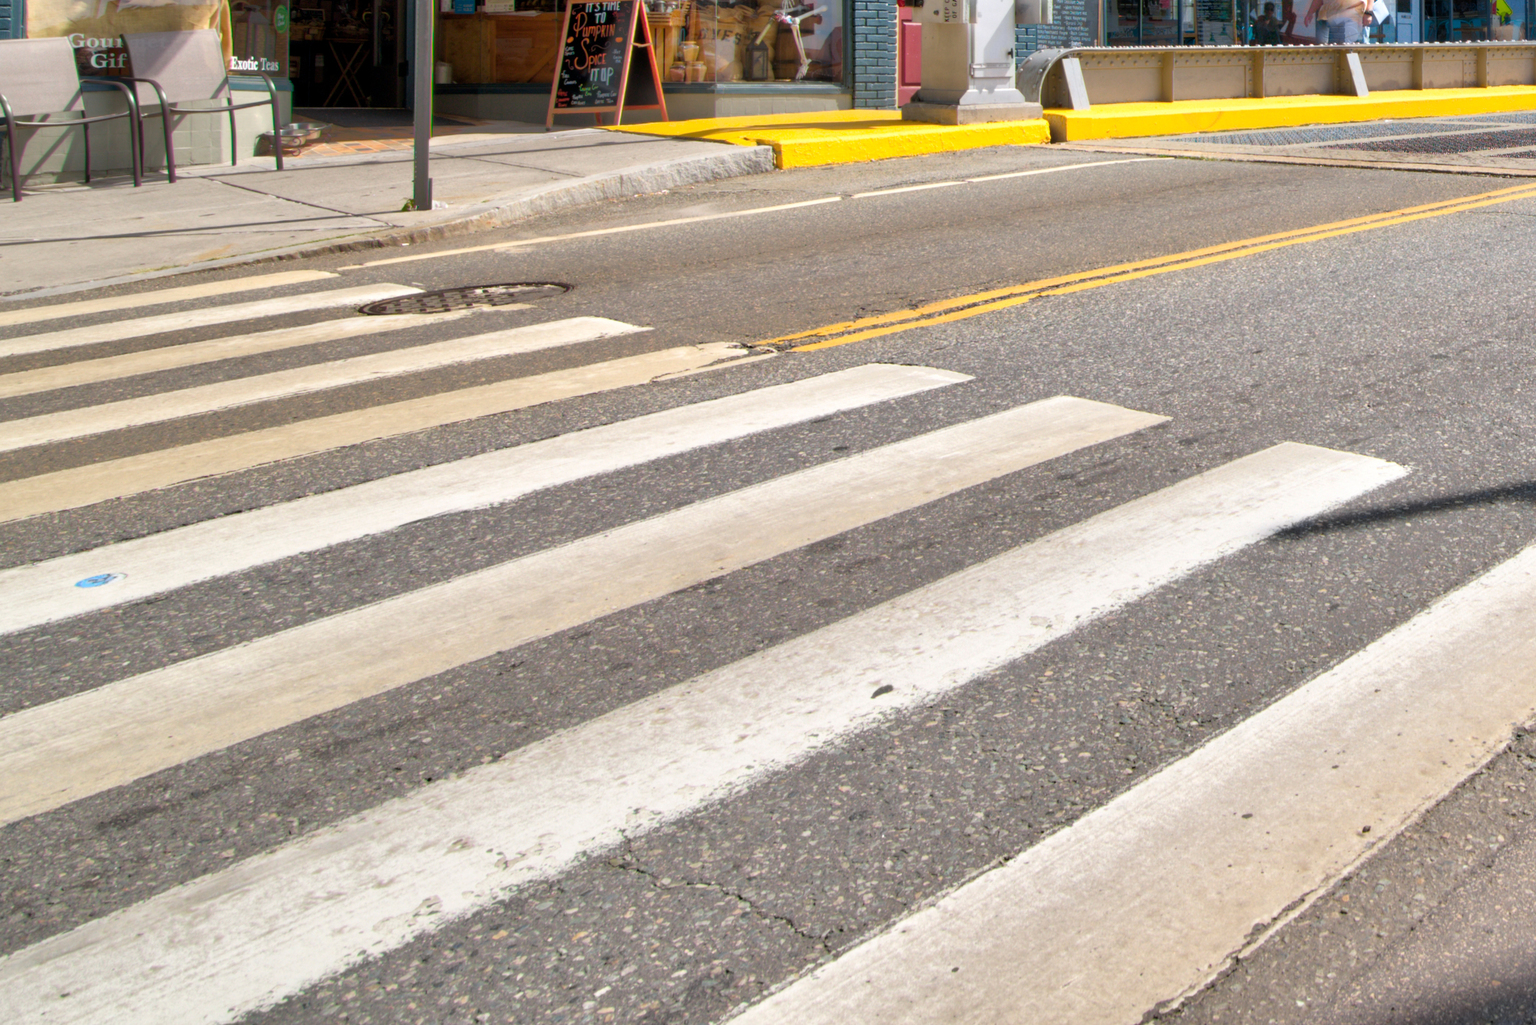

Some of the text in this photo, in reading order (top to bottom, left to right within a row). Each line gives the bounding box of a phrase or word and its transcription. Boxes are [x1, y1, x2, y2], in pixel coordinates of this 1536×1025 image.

[585, 0, 621, 13] IT'S TIME
[594, 11, 607, 24] TO
[951, 11, 958, 19] OF
[230, 56, 279, 72] Exotic Teas
[590, 67, 600, 82] IT
[600, 66, 614, 86] UP
